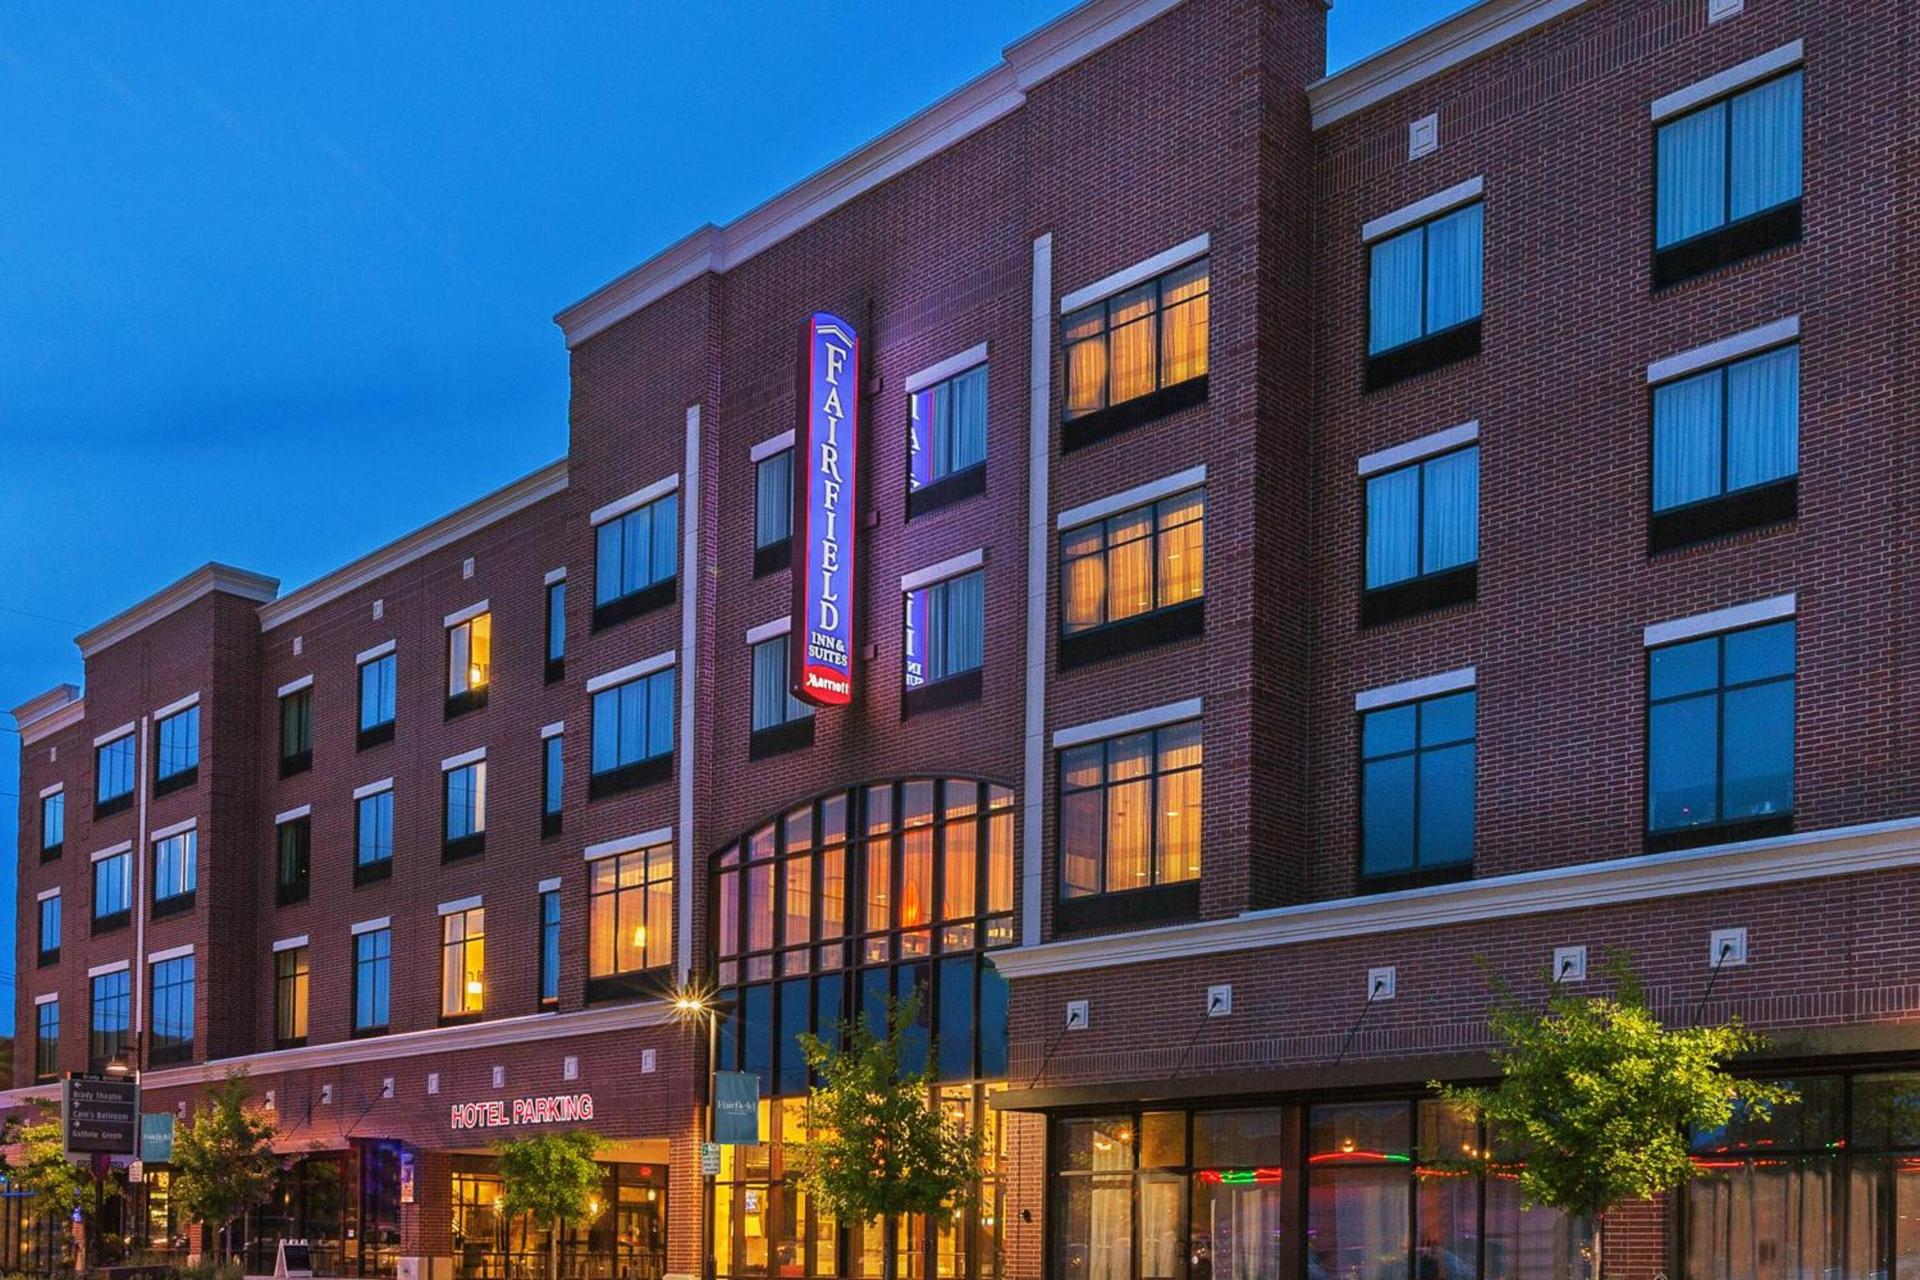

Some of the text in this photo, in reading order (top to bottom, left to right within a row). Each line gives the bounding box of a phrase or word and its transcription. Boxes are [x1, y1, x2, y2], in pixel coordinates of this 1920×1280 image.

[819, 342, 846, 631] FAIRFIELD
[808, 644, 848, 667] SUITES
[806, 672, 849, 695] Marriott
[73, 1090, 123, 1101] Brady Theatre
[73, 1110, 129, 1120] Cain's Ballroom
[451, 1094, 593, 1128] HOTEL PARKING
[72, 1128, 122, 1139] Guthrie Green
